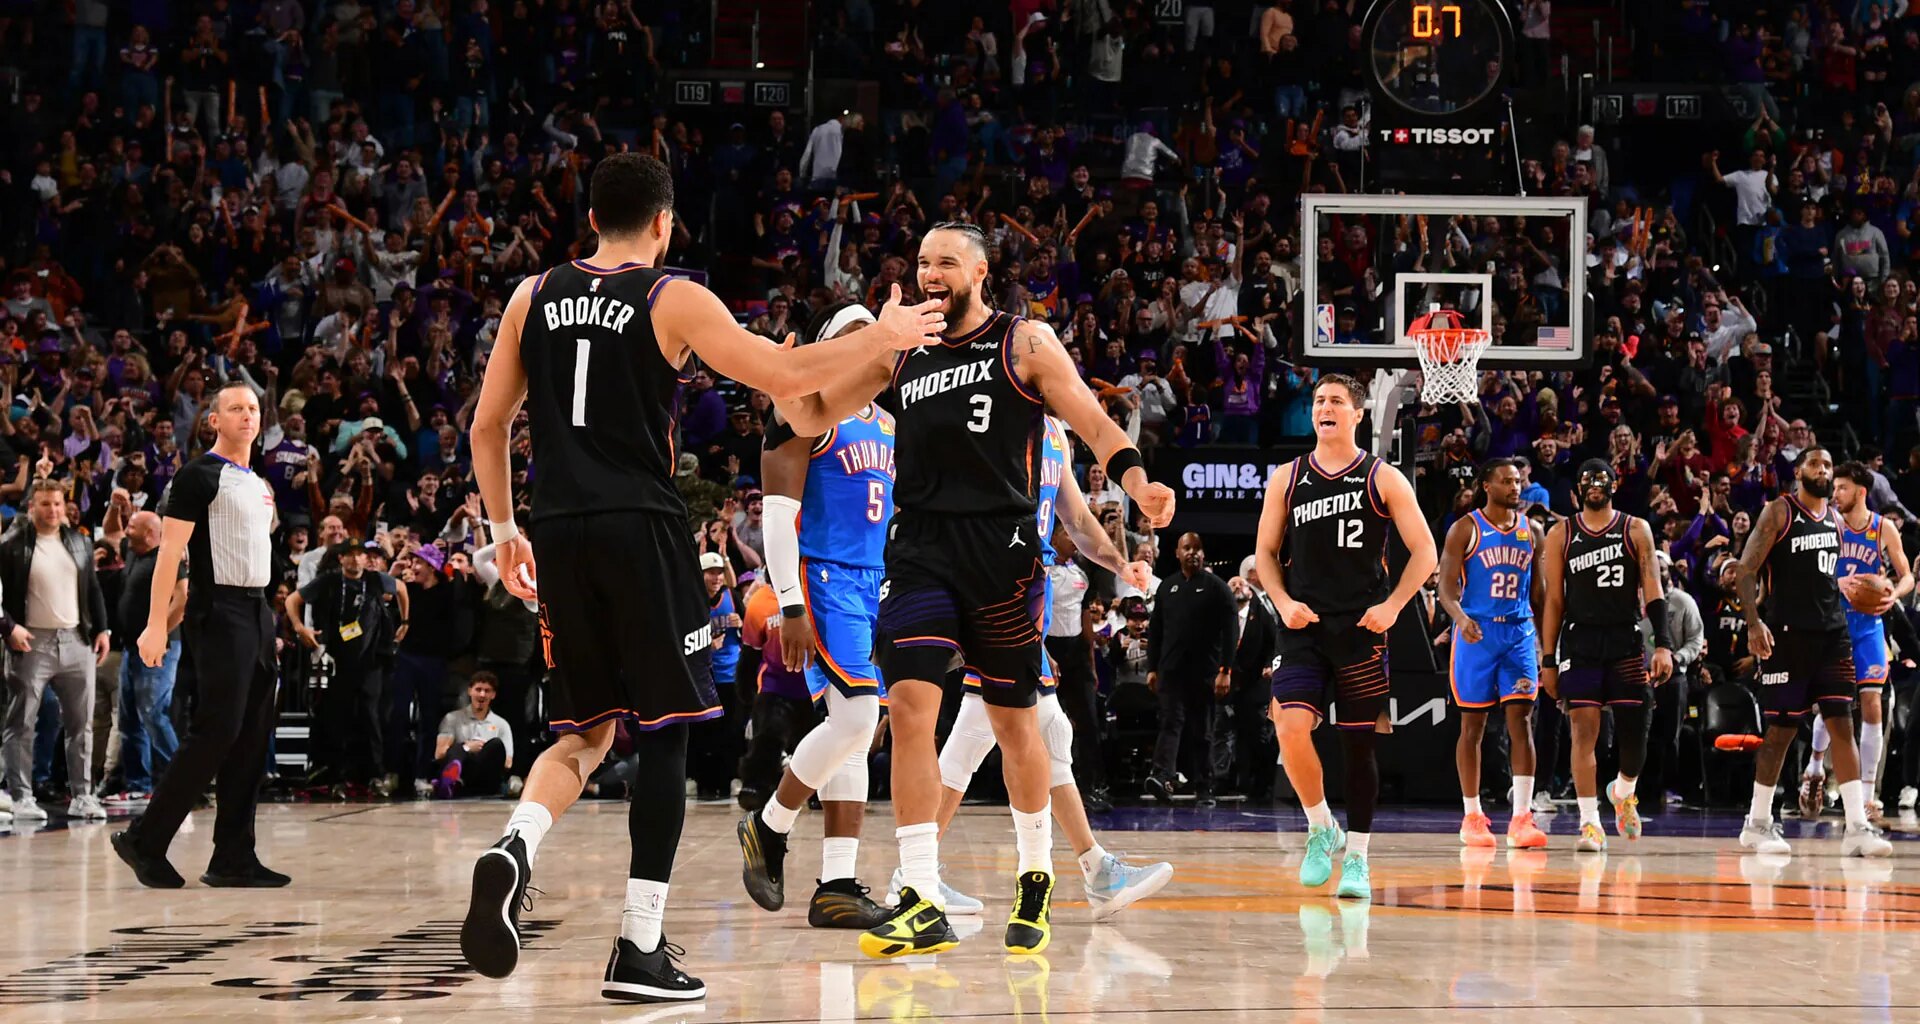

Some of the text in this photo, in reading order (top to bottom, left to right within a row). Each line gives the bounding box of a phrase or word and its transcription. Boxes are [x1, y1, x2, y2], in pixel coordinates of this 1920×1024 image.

[1413, 5, 1461, 38] 0.7
[683, 86, 705, 101] 119
[761, 86, 785, 101] 120
[1673, 99, 1694, 115] 121
[1411, 128, 1495, 144] TISSOT
[544, 296, 635, 334] BOOKER
[971, 342, 998, 351] PayPal
[572, 338, 591, 427] 1
[900, 358, 995, 410] PHOENIX
[967, 394, 993, 433] 3
[836, 440, 897, 481] THUNDE
[1182, 463, 1281, 489] GIN&J
[867, 480, 885, 524] 5
[1185, 489, 1204, 499] BY
[1214, 489, 1246, 499] DRE
[1038, 498, 1052, 537] 9
[1293, 490, 1364, 527] PHOENIX
[1337, 518, 1364, 548] 12
[1791, 531, 1838, 553] PHOENIX
[1478, 545, 1532, 572] THUNDER
[1569, 542, 1624, 574] PHOENIX
[1817, 550, 1838, 576] 00
[1490, 572, 1519, 599] 22
[1596, 565, 1624, 588] 23
